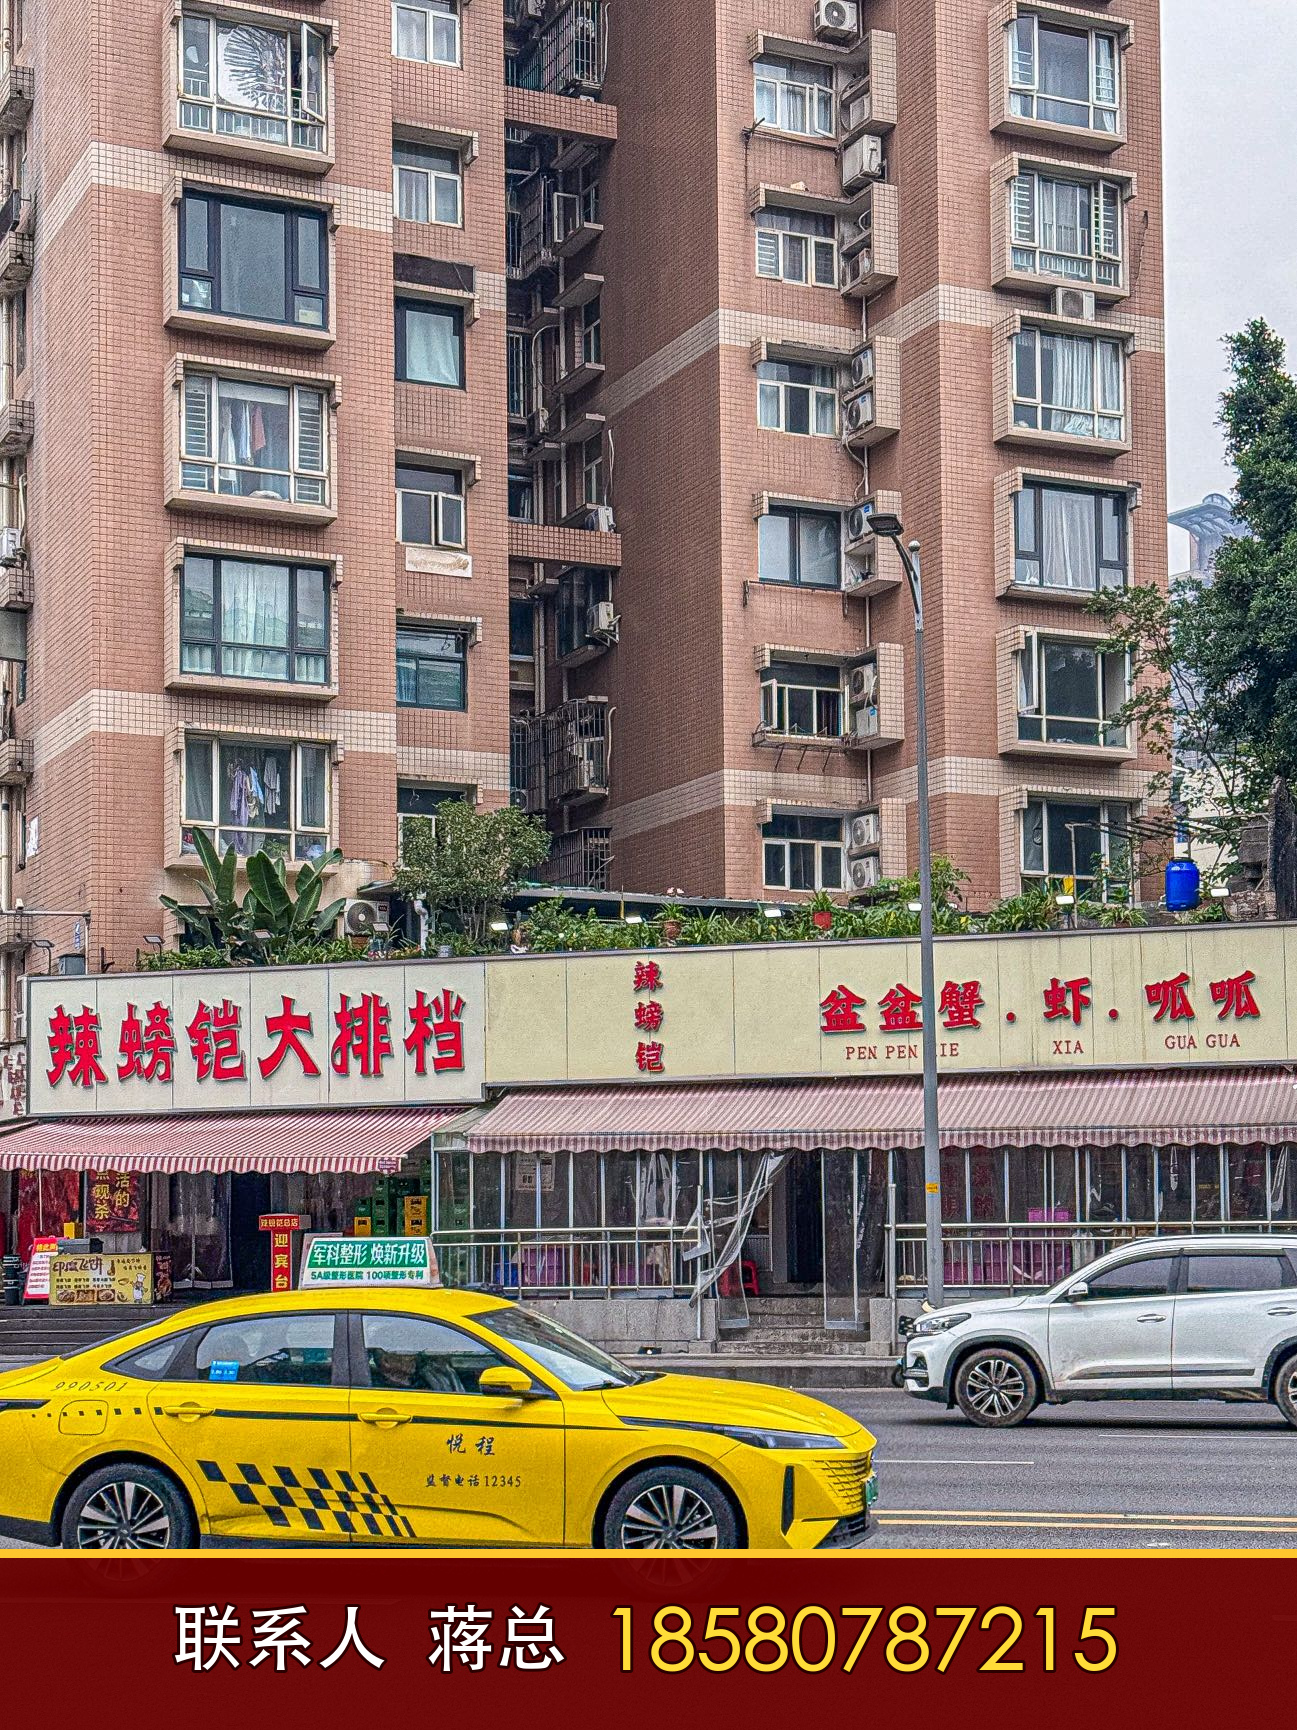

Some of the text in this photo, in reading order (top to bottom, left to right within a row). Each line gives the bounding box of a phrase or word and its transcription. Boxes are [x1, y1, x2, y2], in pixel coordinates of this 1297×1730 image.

[820, 970, 1261, 1033] 盆盆蟹 虾 呱呱
[633, 960, 664, 1073] 辣螃铠
[46, 988, 468, 1088] 辣螃铠大排档
[1052, 1040, 1085, 1055] XIA
[1164, 1033, 1241, 1050] GUA GUA
[845, 1046, 878, 1060] PEN
[885, 1044, 919, 1059] PEN
[274, 1233, 289, 1289] 迎宾台
[312, 1243, 425, 1266] 军科整形 焕新升级
[50, 1381, 129, 1392] 990501
